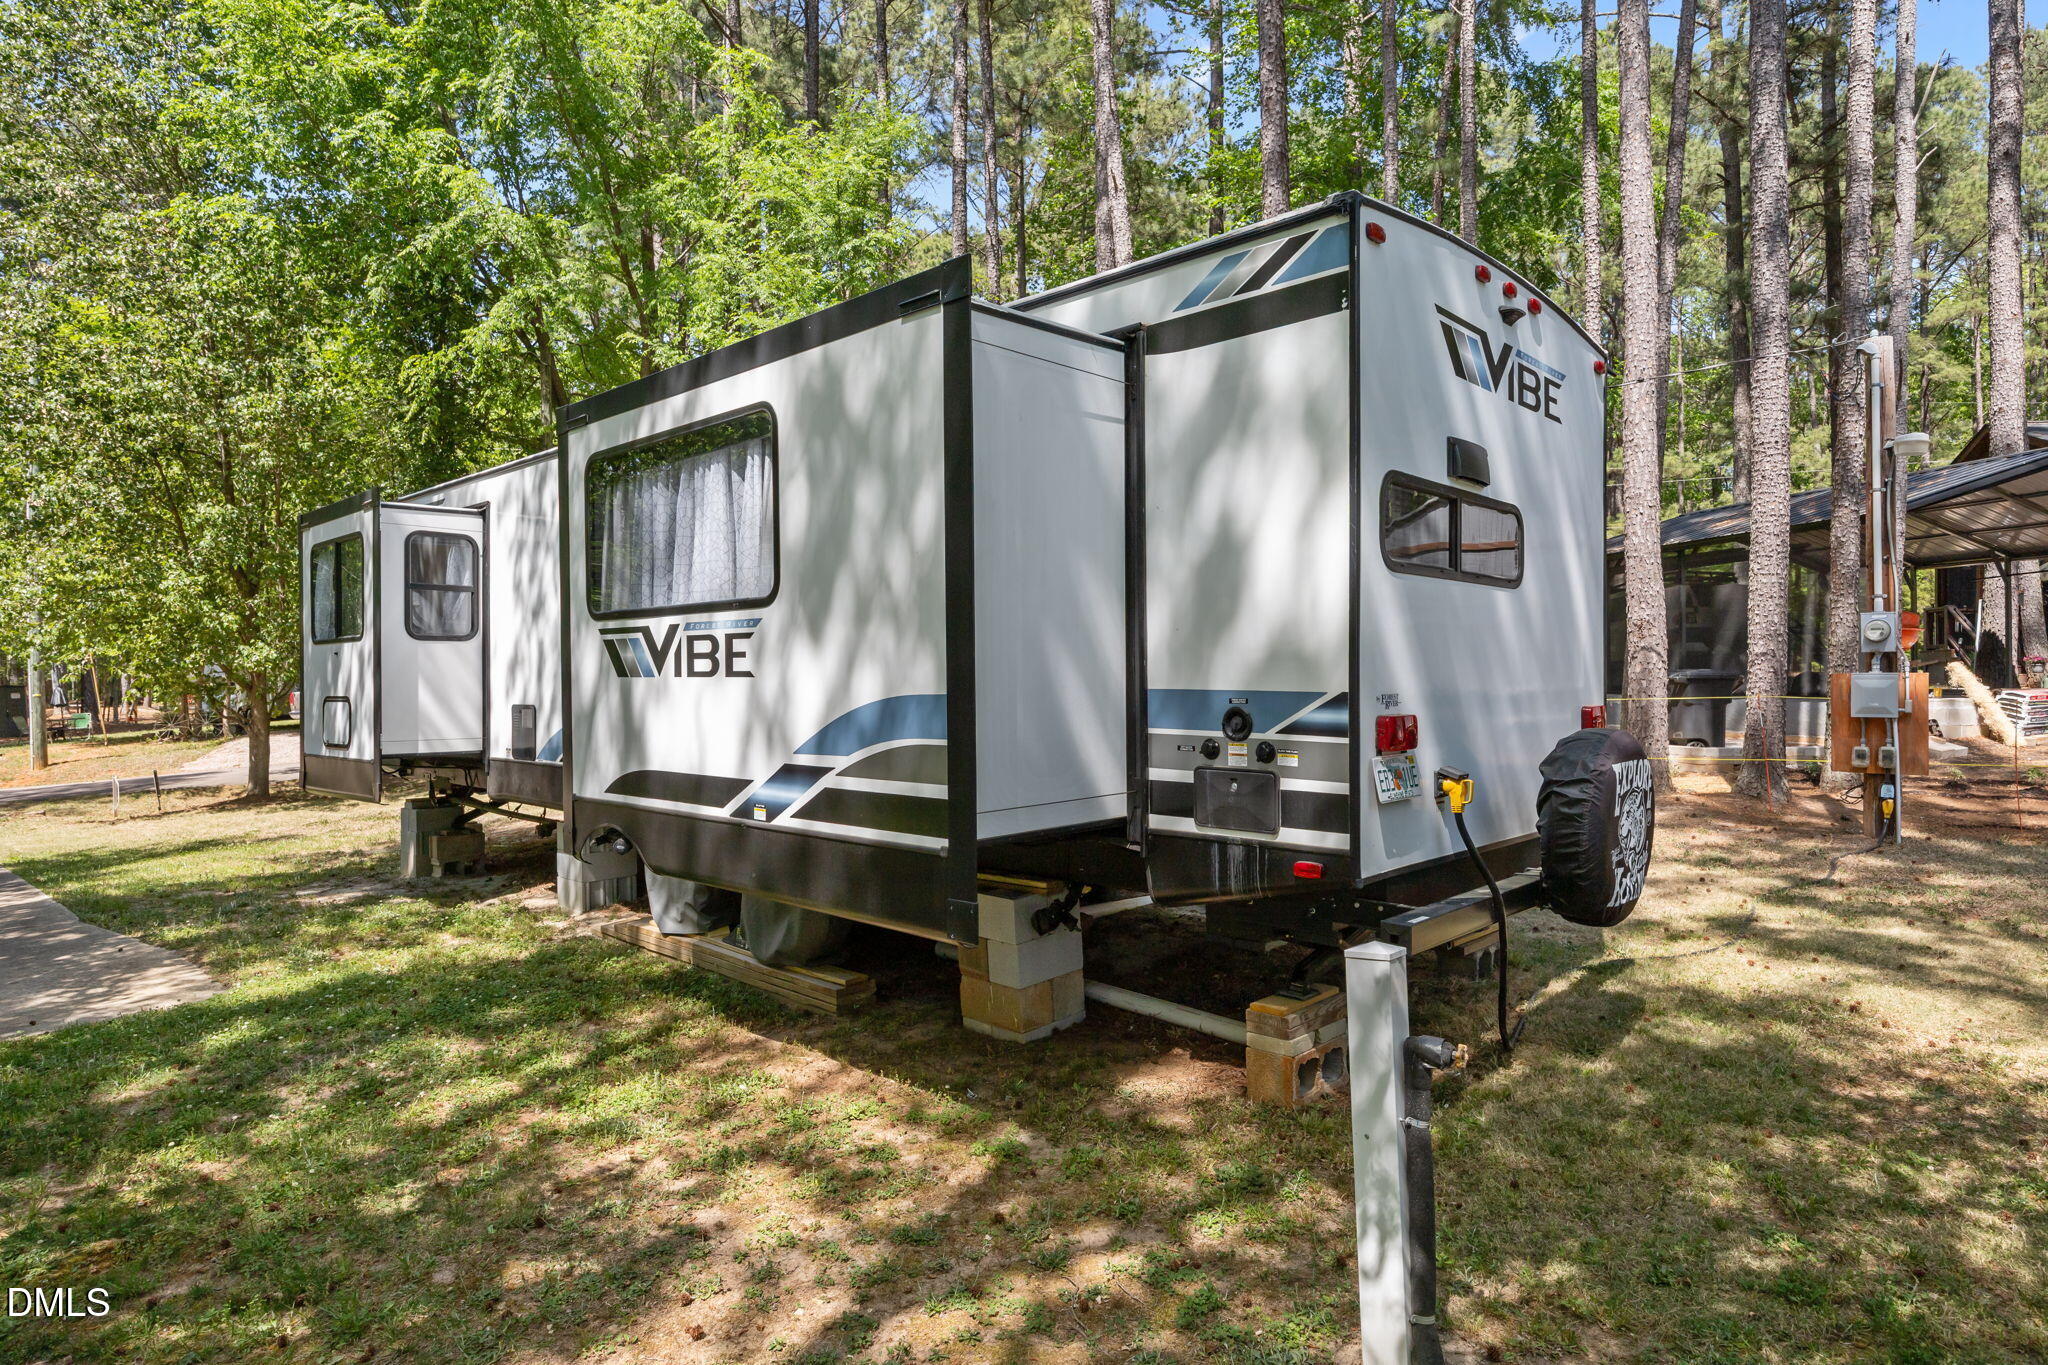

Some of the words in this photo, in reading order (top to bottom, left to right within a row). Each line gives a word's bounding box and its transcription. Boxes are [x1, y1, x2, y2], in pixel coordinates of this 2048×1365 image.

[1434, 303, 1563, 425] VIBE
[598, 623, 756, 678] VIBE
[1611, 759, 1653, 817] EXPLORE
